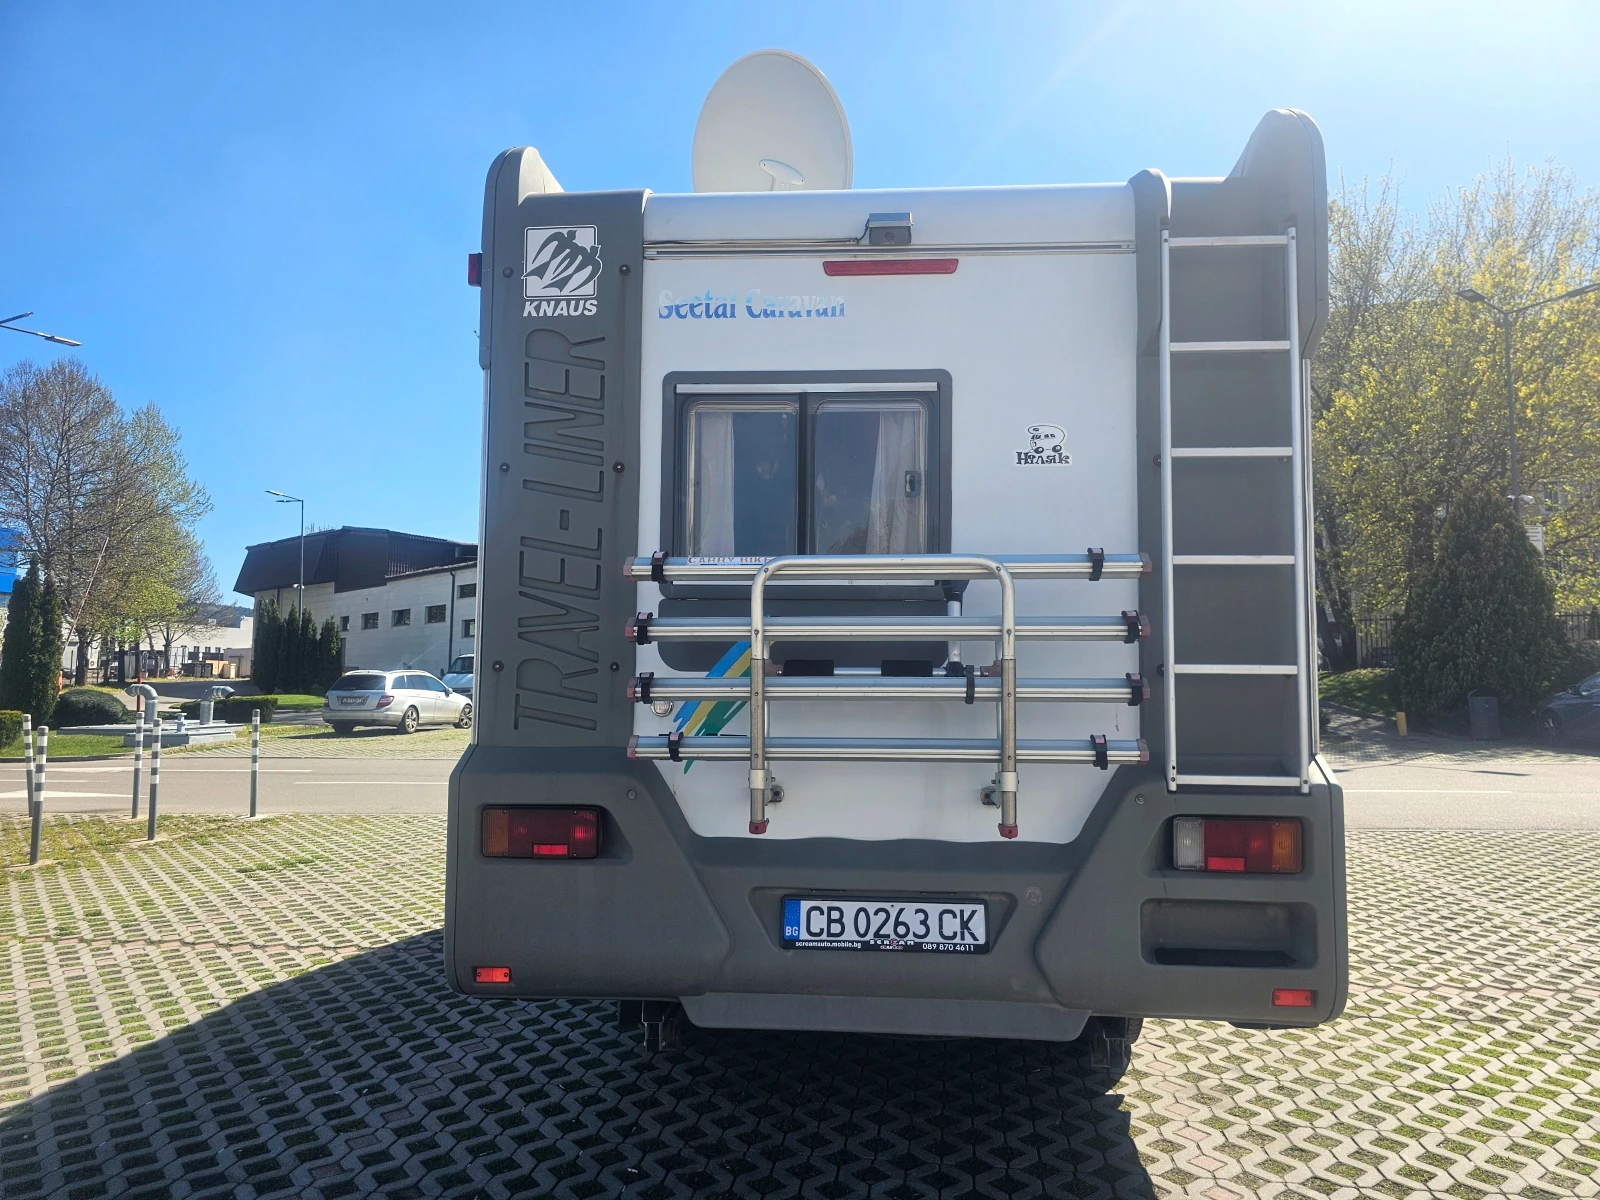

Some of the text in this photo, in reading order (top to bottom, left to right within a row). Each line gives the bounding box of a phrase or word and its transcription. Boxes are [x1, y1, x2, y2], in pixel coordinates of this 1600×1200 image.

[522, 300, 598, 317] KNAUS
[658, 288, 845, 320] Seetal Caravan
[514, 328, 606, 731] TRAVEL-LINER
[785, 926, 799, 937] BG
[805, 906, 980, 942] CB 0263 CK
[795, 941, 862, 949] screamauto.mobile.bg
[869, 938, 915, 946] SCREAM
